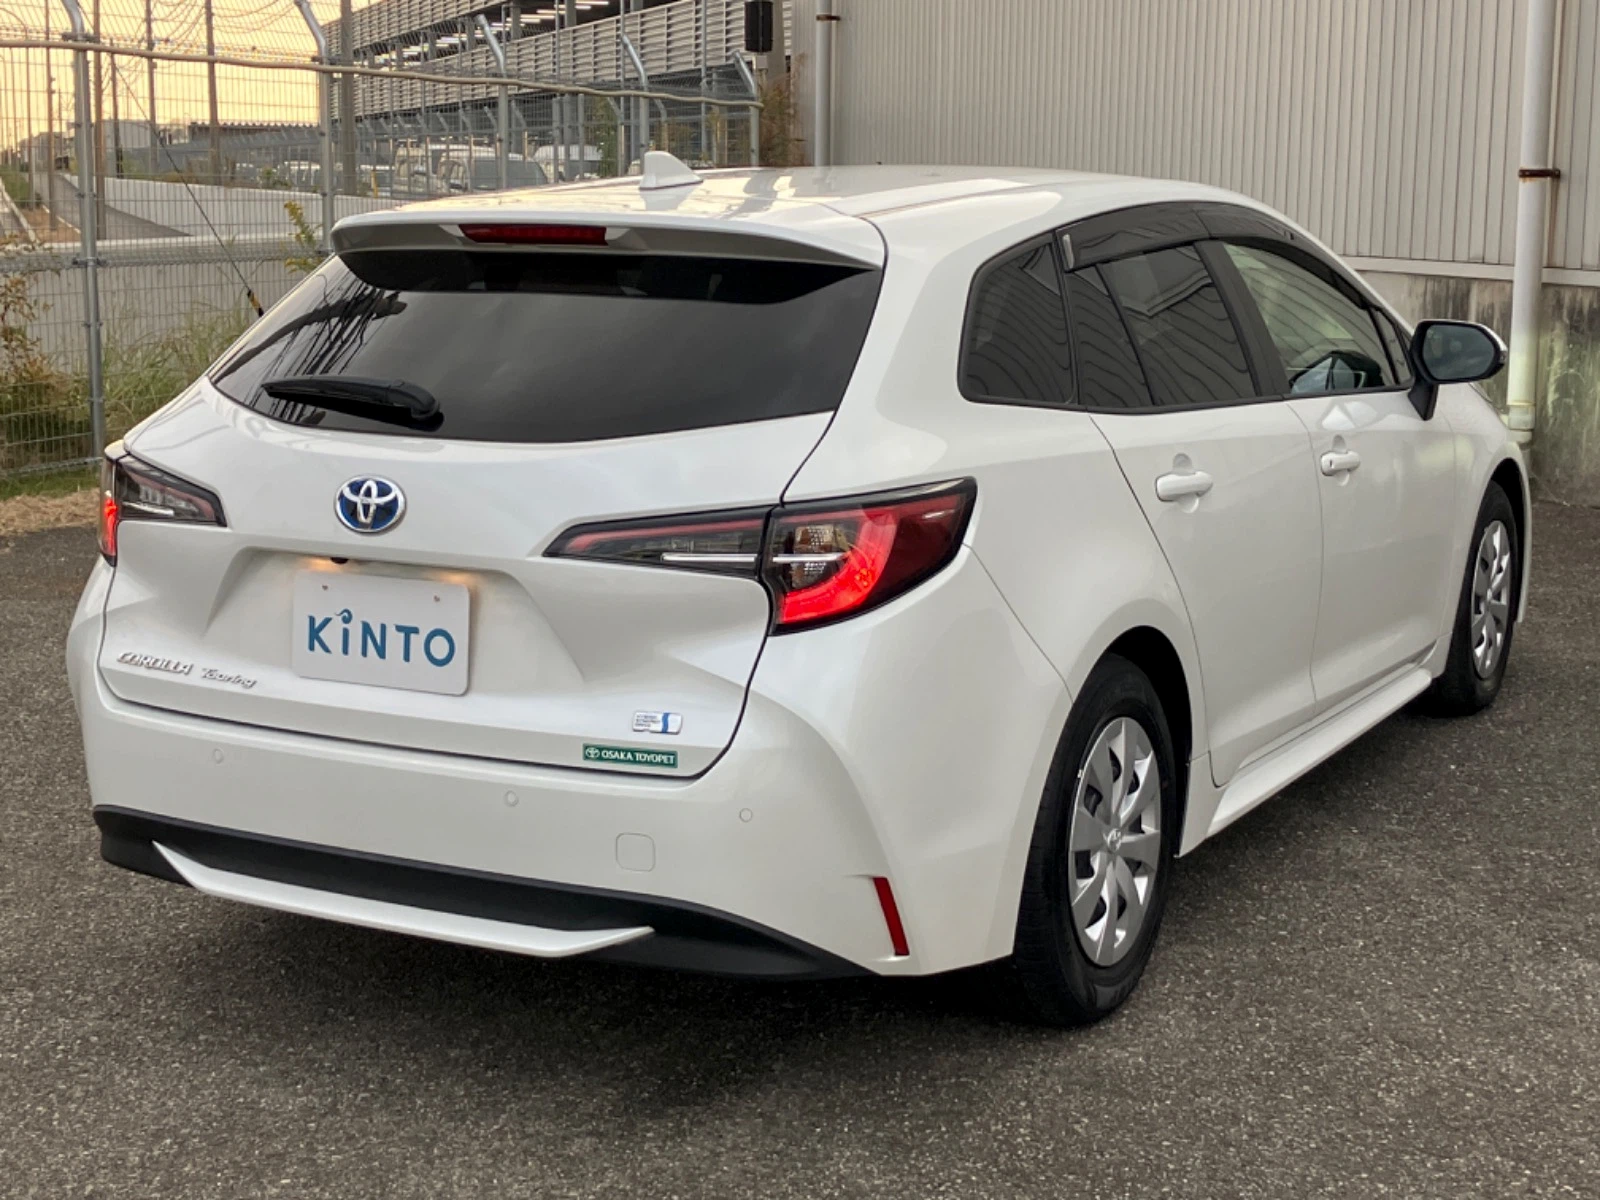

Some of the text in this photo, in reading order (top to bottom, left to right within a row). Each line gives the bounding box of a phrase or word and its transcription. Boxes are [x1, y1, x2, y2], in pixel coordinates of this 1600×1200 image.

[117, 651, 257, 689] COROLLA Touring
[601, 750, 675, 765] OSAKA TOYOPET
